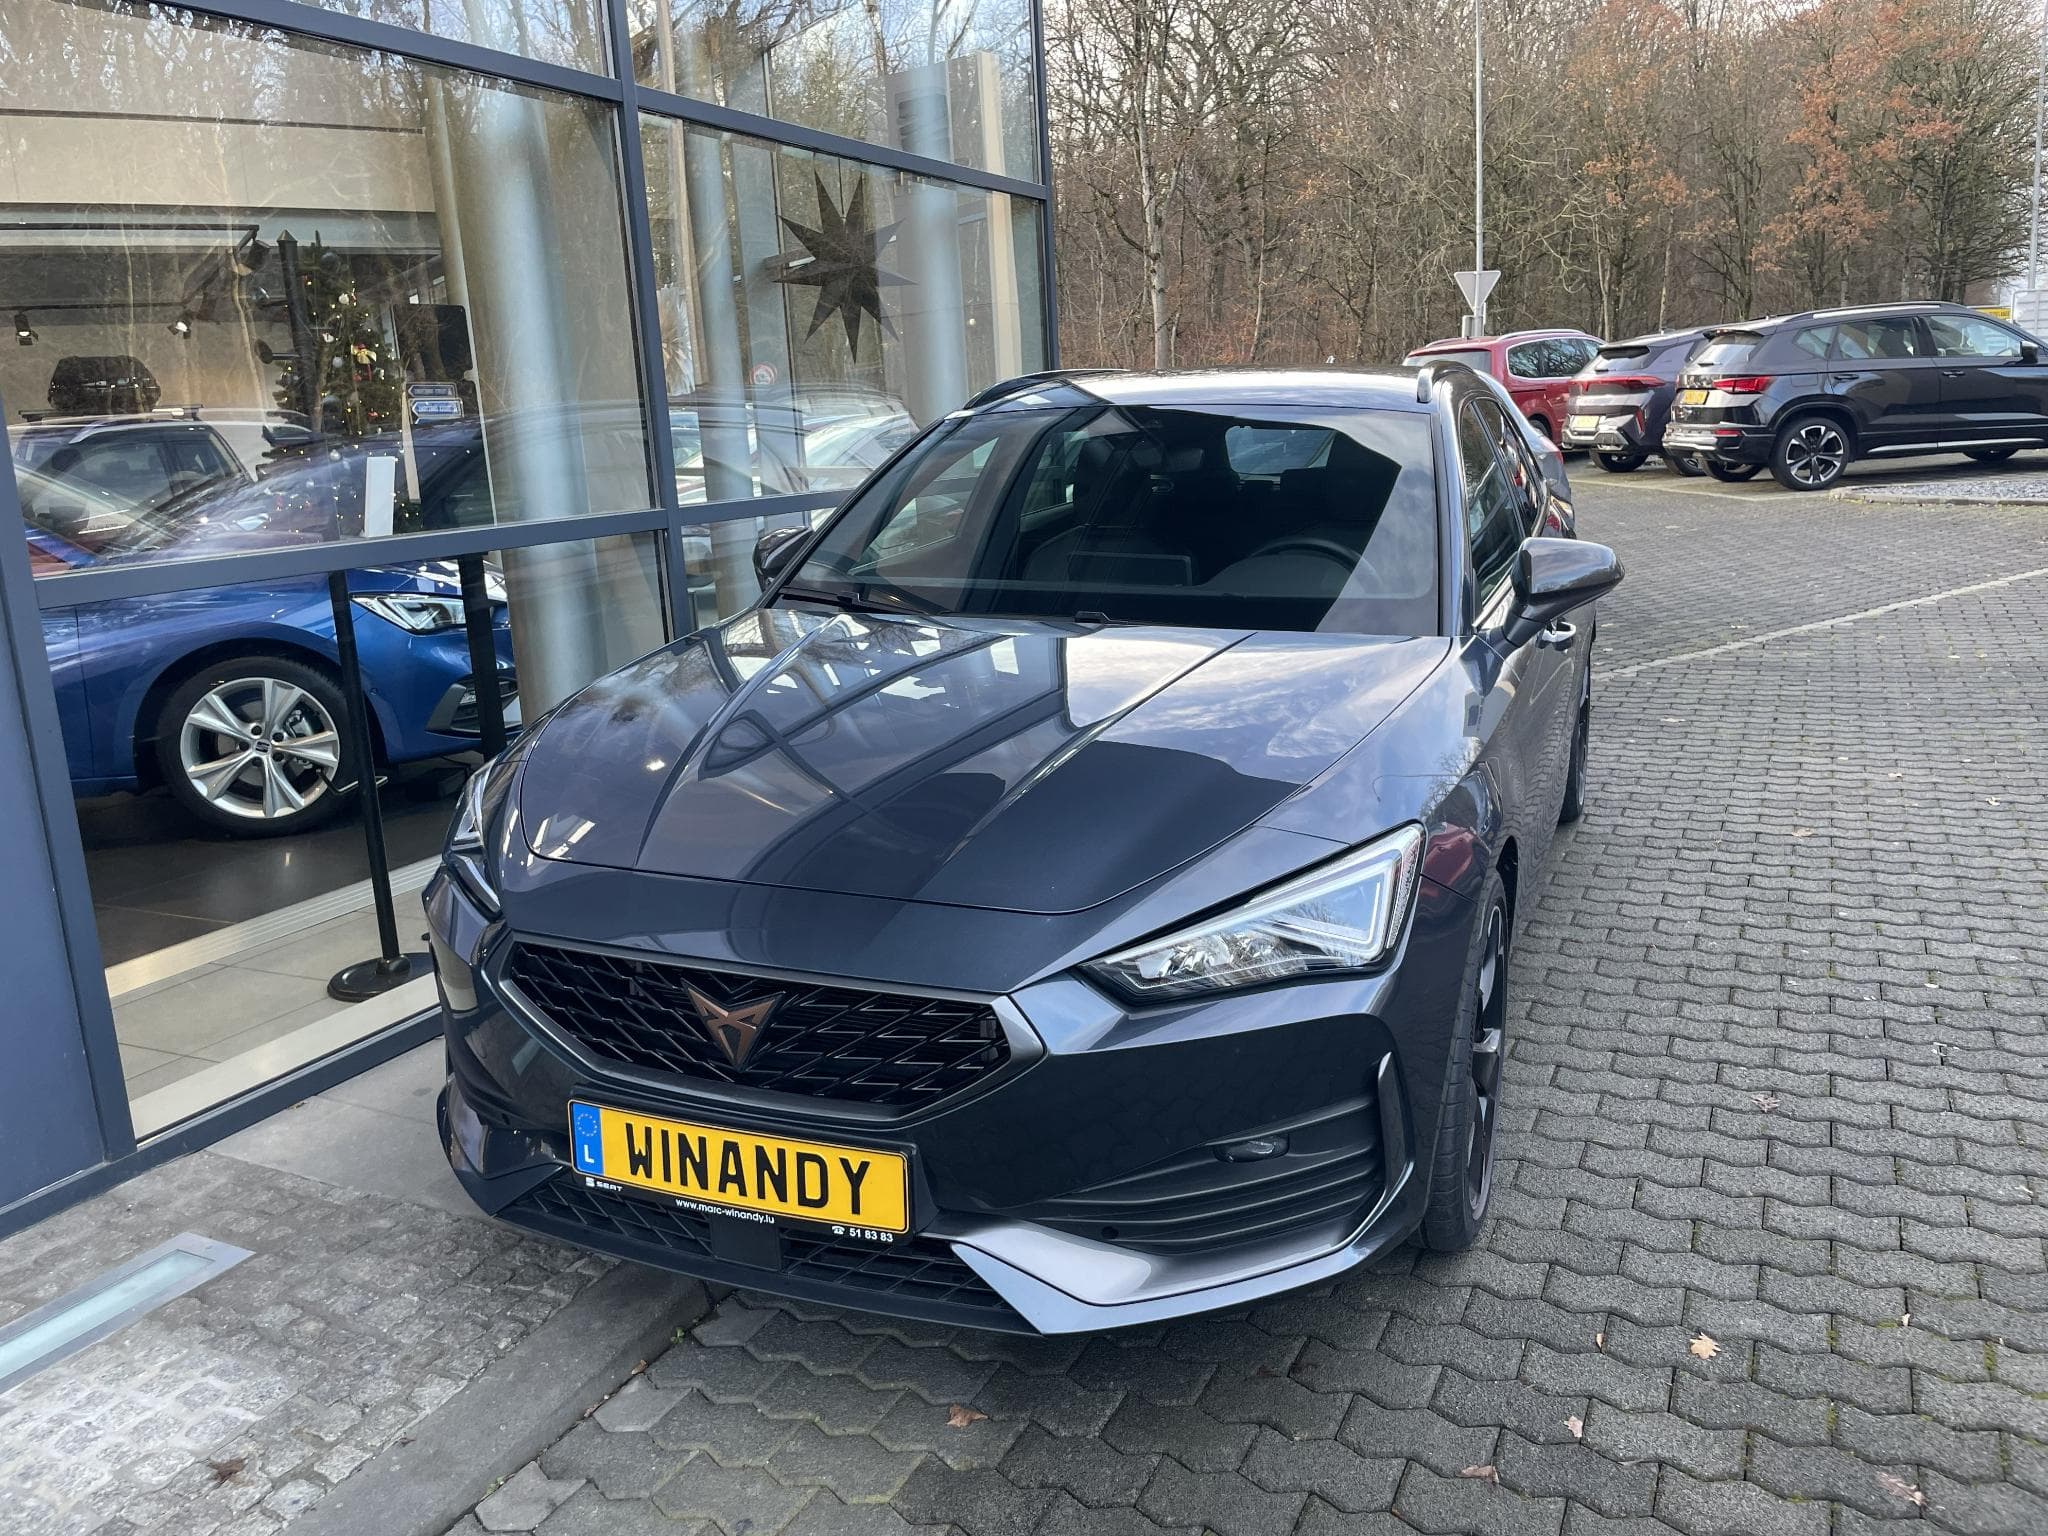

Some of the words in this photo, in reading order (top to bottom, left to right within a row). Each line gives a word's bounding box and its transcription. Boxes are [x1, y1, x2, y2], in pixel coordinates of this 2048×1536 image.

[584, 1144, 595, 1163] L
[625, 1122, 871, 1215] WINANDY
[596, 1180, 623, 1192] SEAT
[675, 1199, 775, 1224] www.marc-winandy.lu
[849, 1227, 861, 1238] 51
[864, 1229, 878, 1240] 83
[880, 1232, 894, 1243] 83
